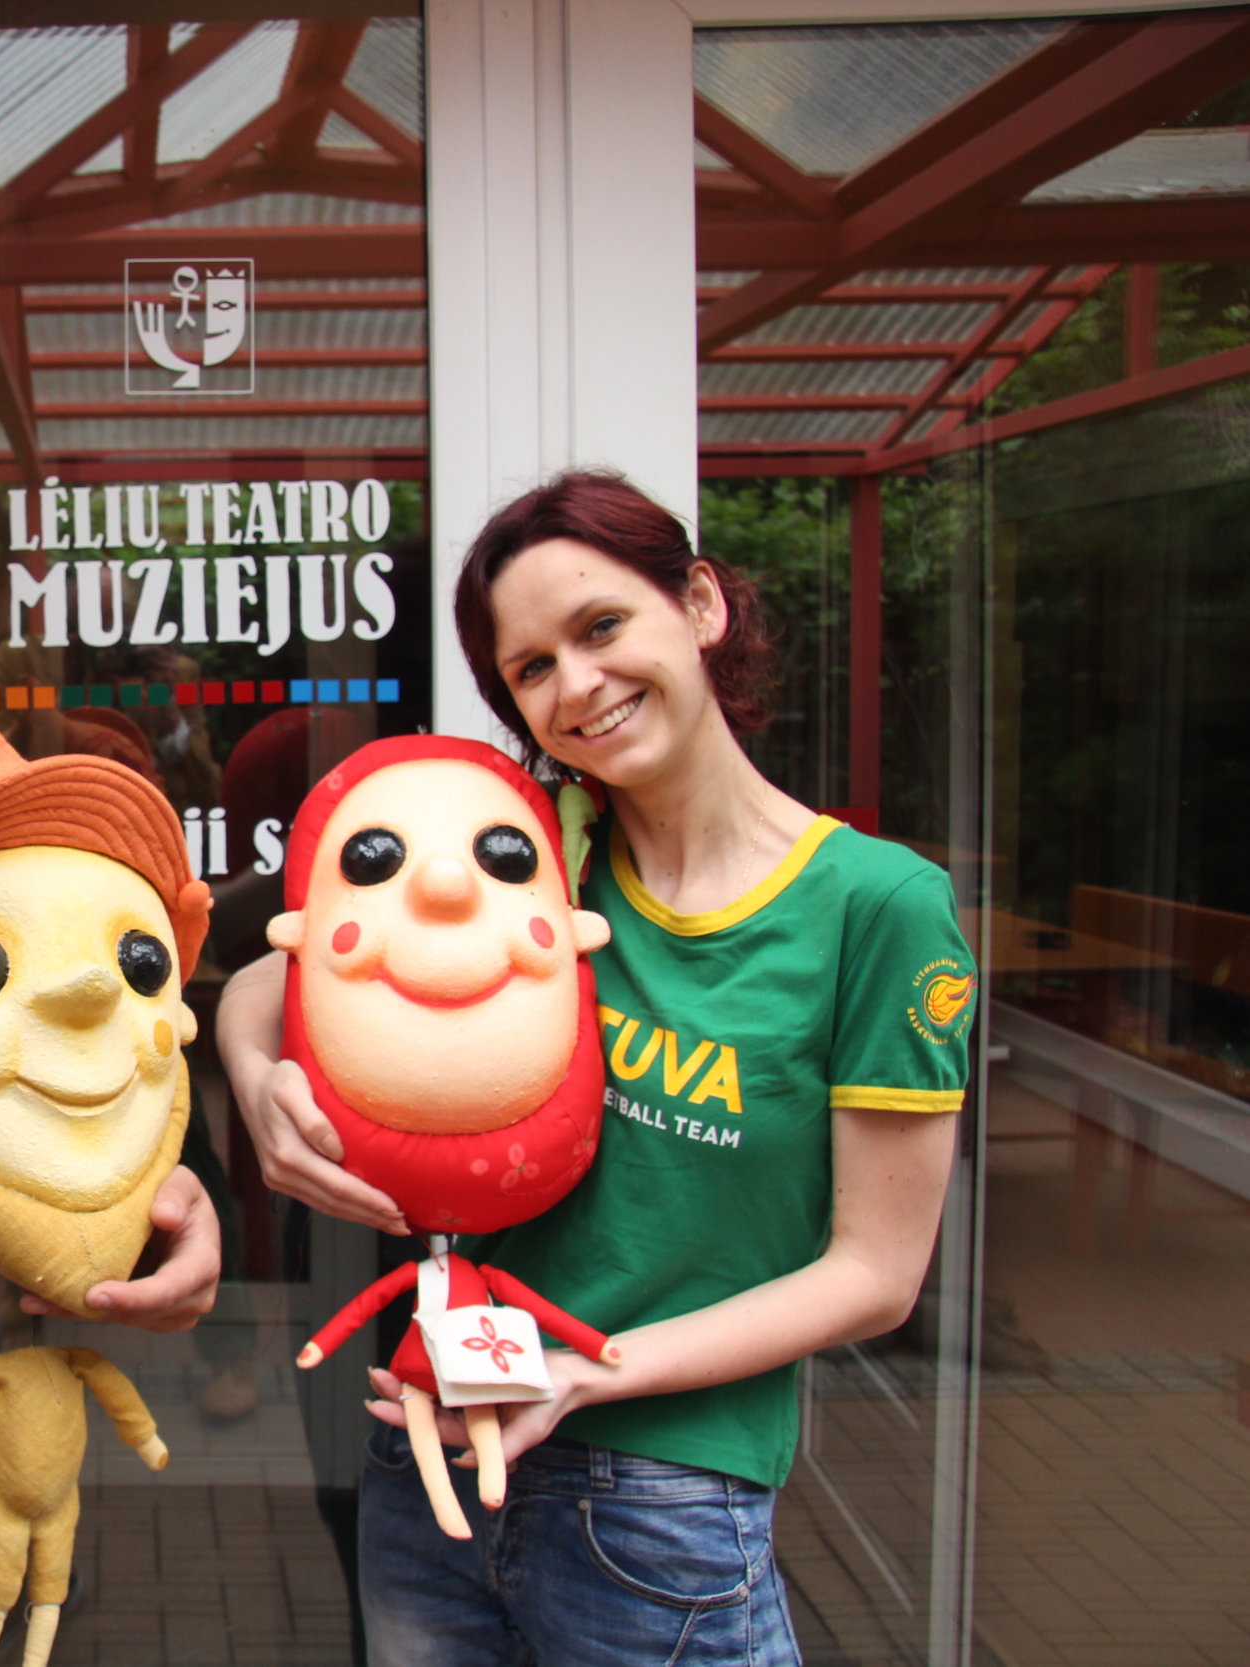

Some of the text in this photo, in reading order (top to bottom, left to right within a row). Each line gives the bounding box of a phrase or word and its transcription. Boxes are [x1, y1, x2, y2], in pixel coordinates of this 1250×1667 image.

[8, 475, 390, 554] LĖLIŲ TEATRO
[7, 552, 396, 657] MUZIEJUS
[674, 1114, 741, 1149] TEAM
